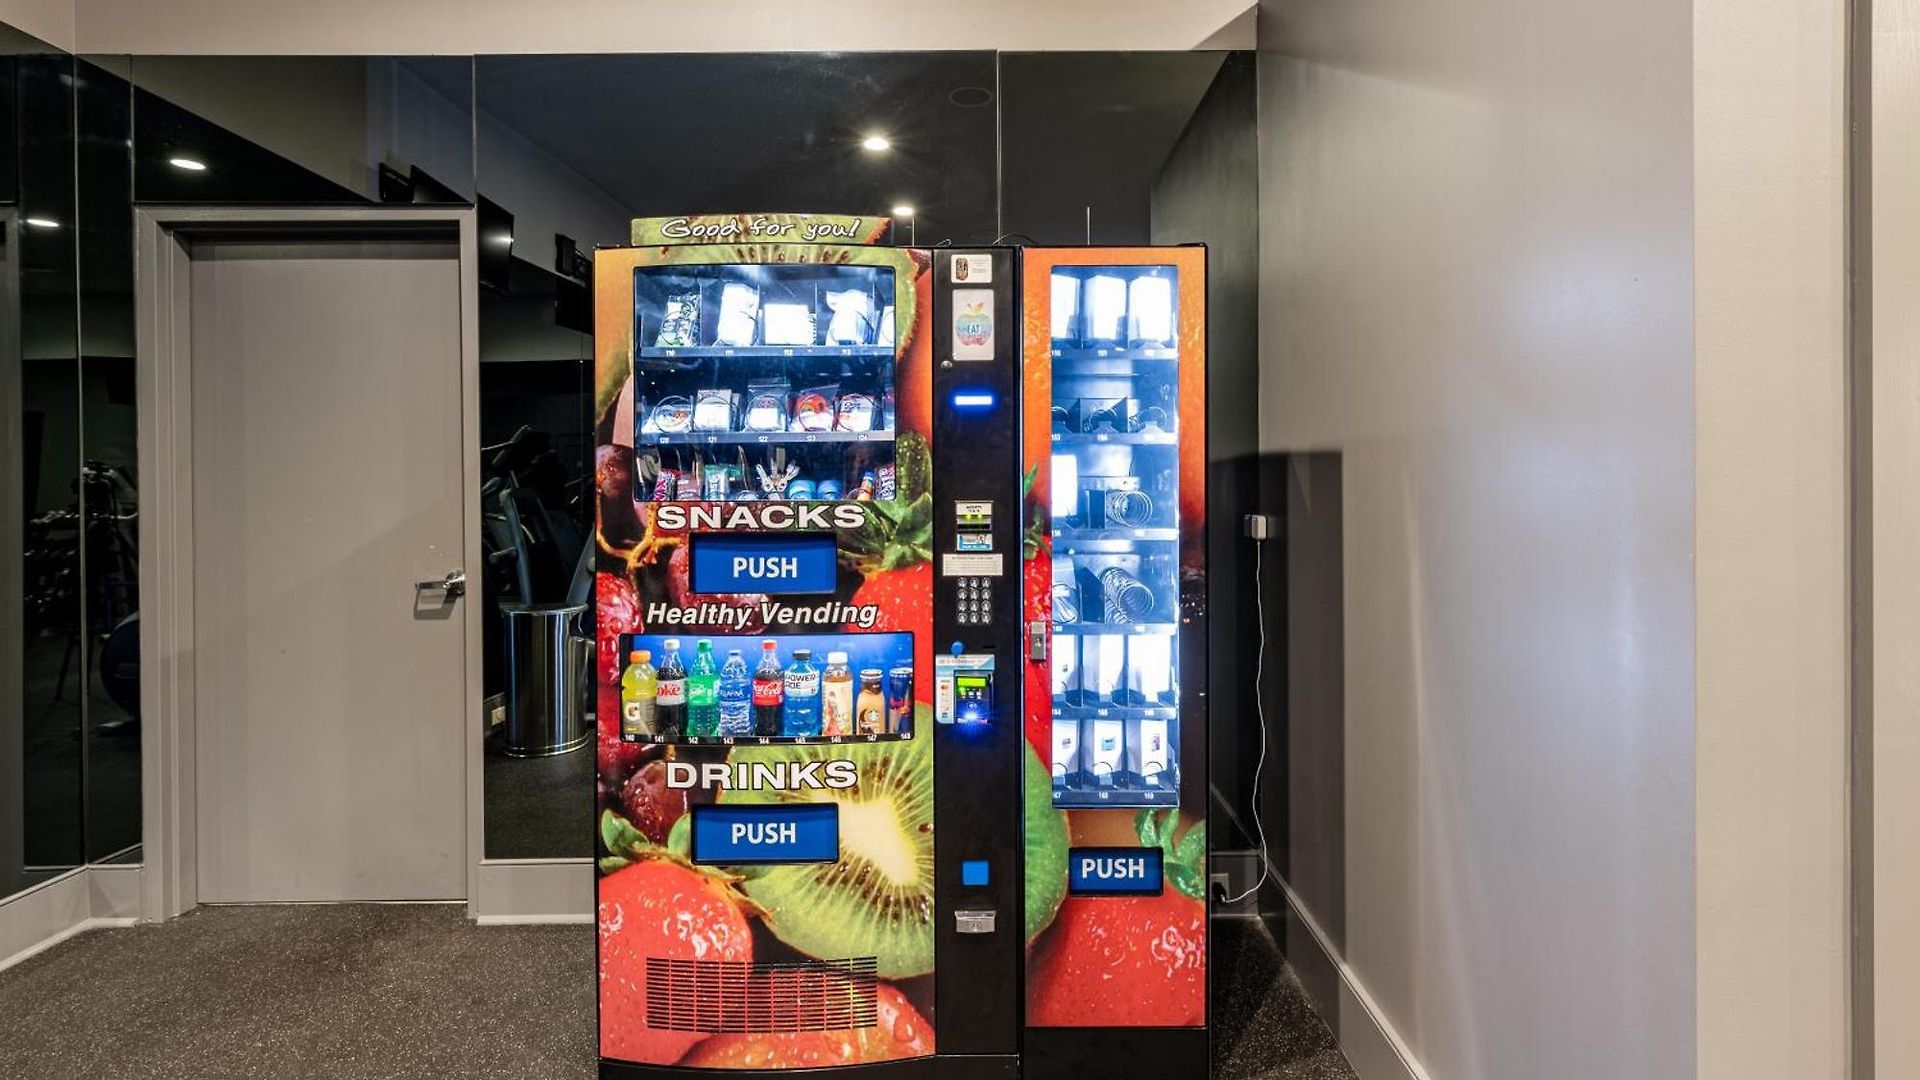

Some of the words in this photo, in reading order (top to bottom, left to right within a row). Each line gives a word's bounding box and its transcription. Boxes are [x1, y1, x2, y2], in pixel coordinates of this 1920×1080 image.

[661, 218, 740, 238] Good
[750, 217, 795, 236] for
[802, 218, 861, 241] you!
[656, 505, 866, 530] SNACKS
[732, 556, 798, 579] PUSH
[646, 602, 753, 630] Healthy
[760, 601, 878, 628] Vending
[654, 735, 664, 743] 141
[723, 737, 734, 745] 143
[759, 737, 769, 745] 144
[867, 734, 877, 742] 147
[666, 760, 858, 790] DRINKS
[731, 822, 797, 845] PUSH
[1081, 858, 1145, 880] PUSH
